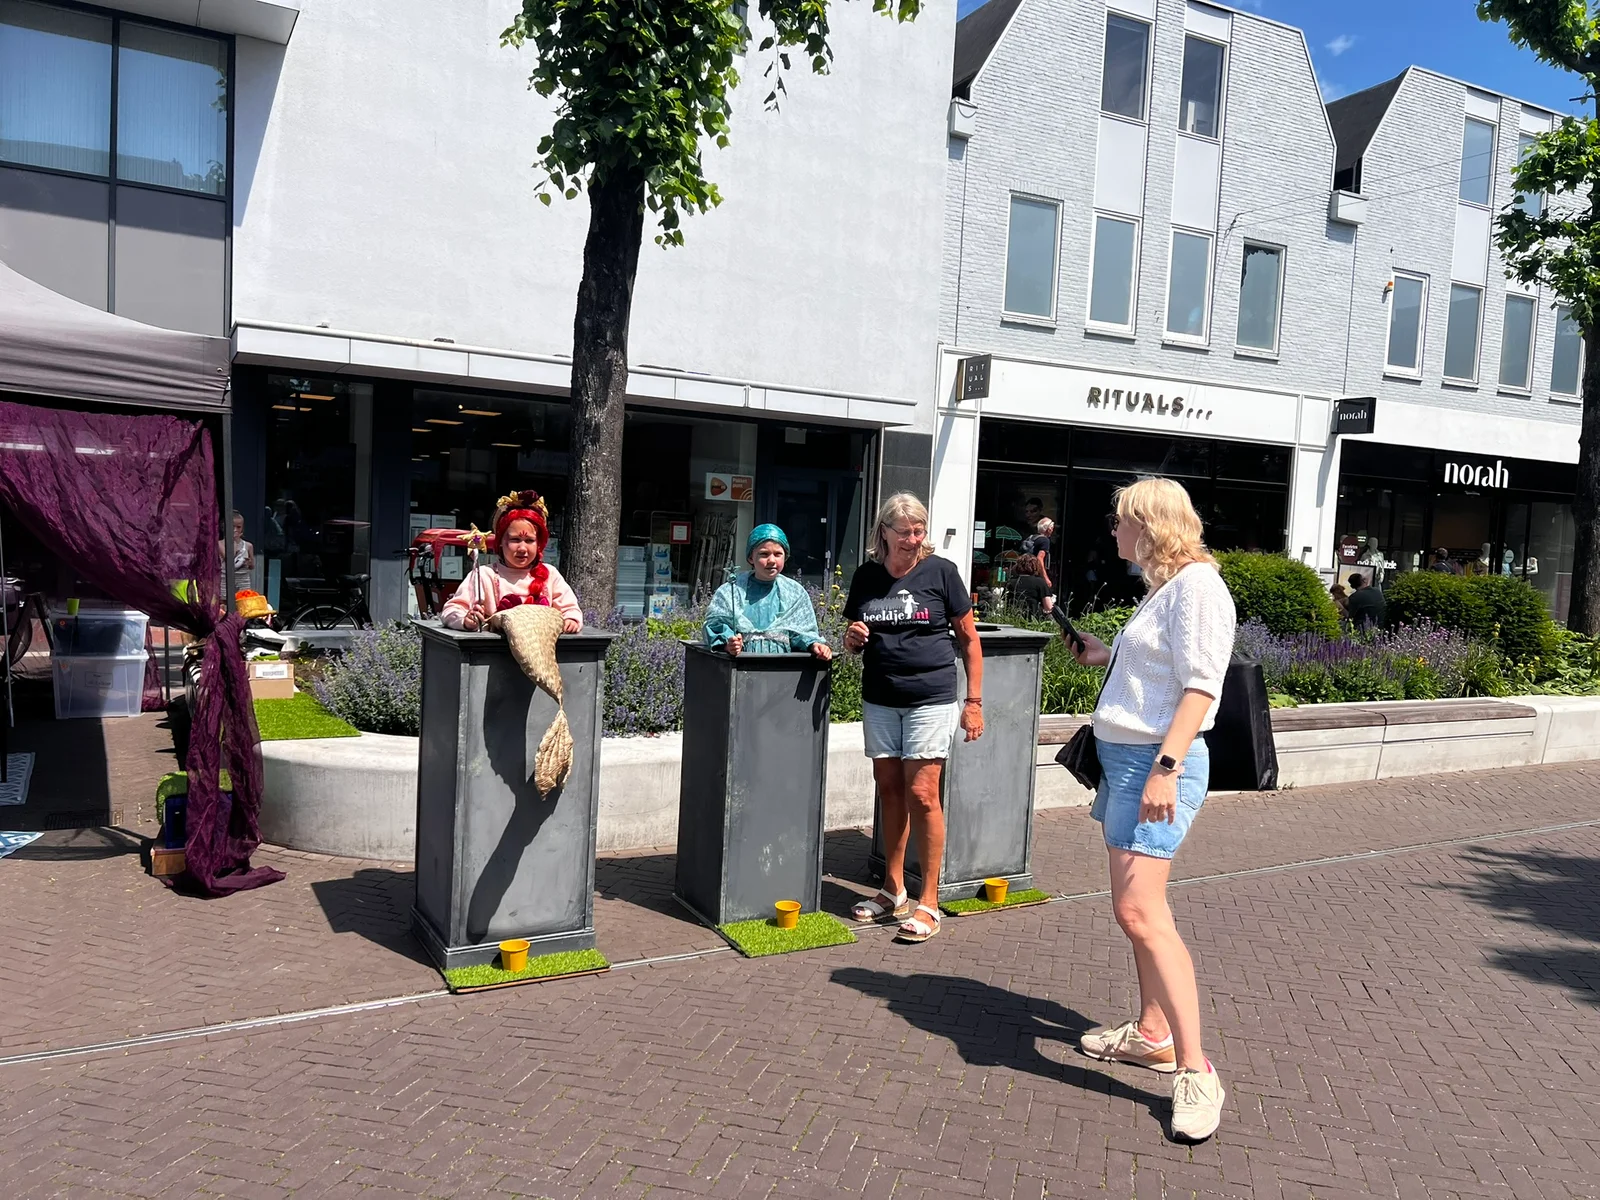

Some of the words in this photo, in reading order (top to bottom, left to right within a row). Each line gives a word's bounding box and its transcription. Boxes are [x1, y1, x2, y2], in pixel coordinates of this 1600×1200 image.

[969, 363, 985, 372] RIT
[968, 374, 984, 382] UAL
[1339, 410, 1367, 421] norah
[1444, 459, 1509, 489] norah
